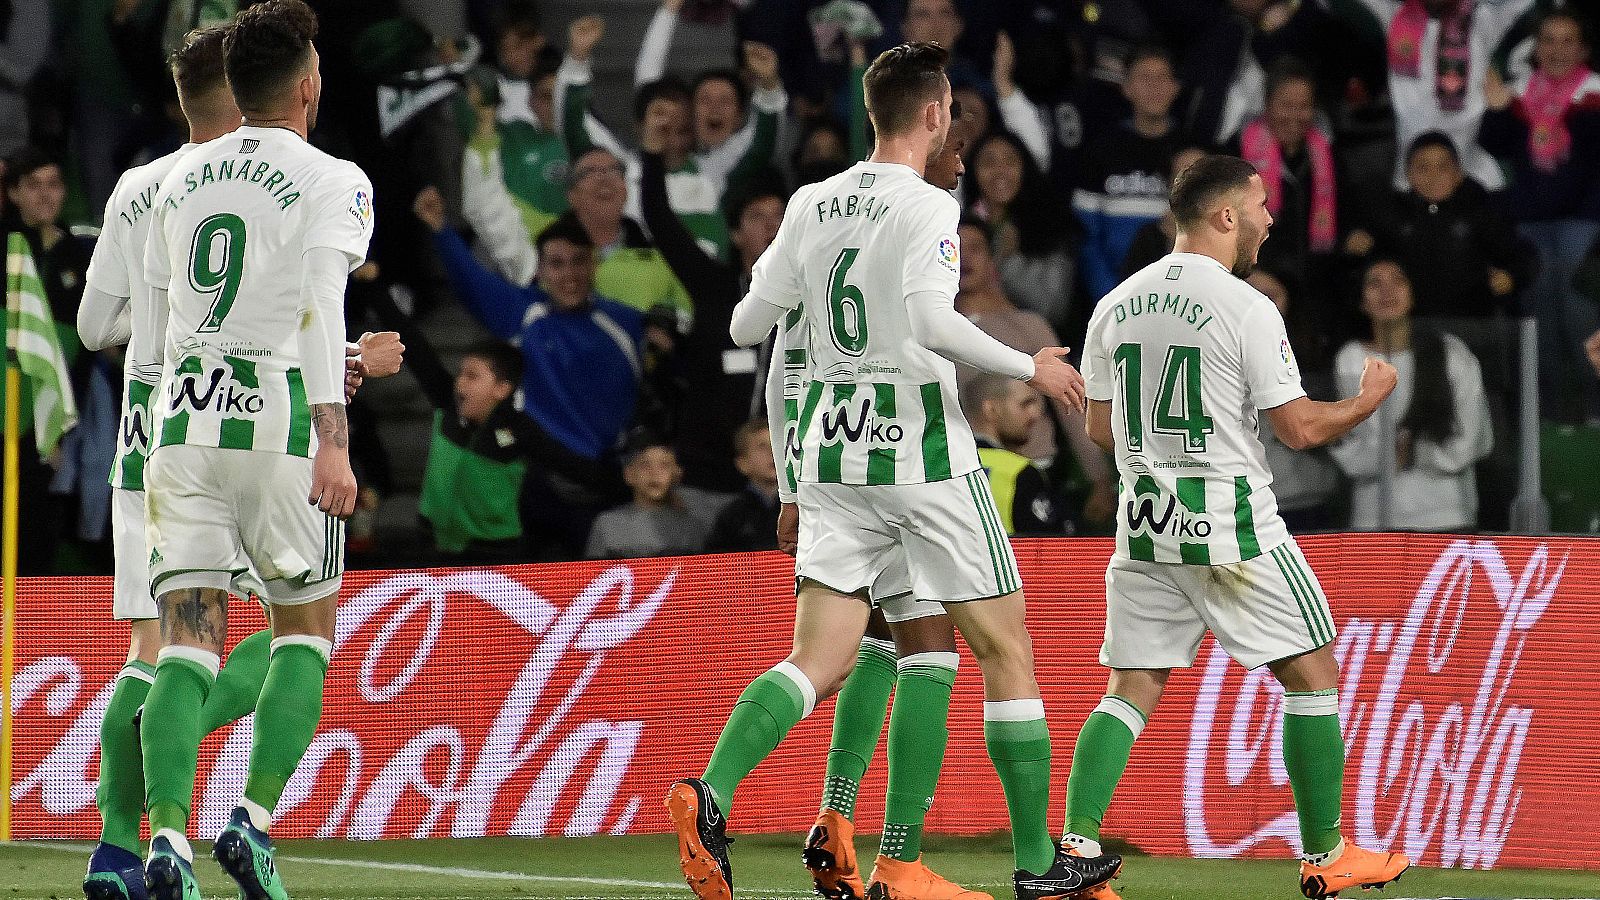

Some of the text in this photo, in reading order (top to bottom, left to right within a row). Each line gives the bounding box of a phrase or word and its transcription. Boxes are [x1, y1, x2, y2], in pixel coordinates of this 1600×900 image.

[185, 159, 302, 211] SANABRIA
[188, 212, 246, 333] 9
[826, 248, 869, 357] 6
[1115, 293, 1213, 332] DURMISI
[168, 368, 264, 413] Wiko
[1113, 342, 1214, 453] 14
[822, 399, 904, 443] Wiko
[1153, 460, 1177, 469] Benito
[1127, 494, 1212, 538] Wiko
